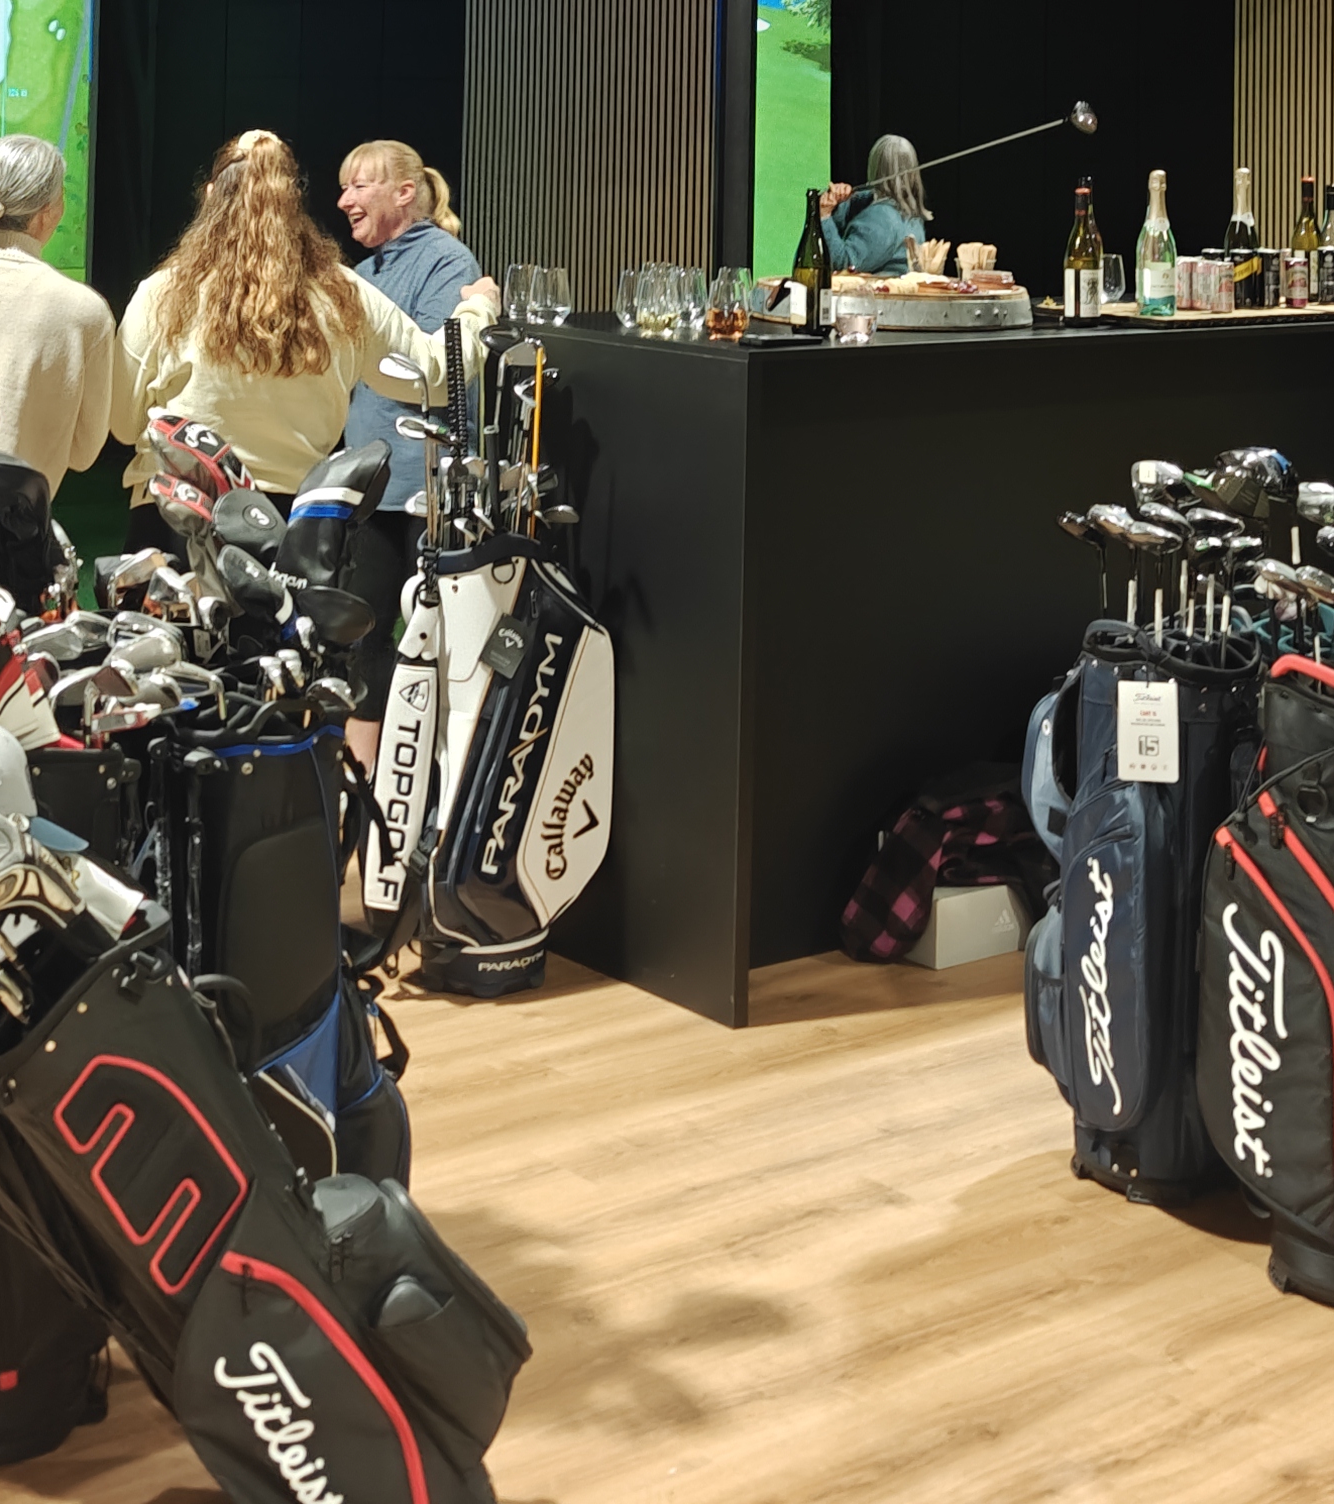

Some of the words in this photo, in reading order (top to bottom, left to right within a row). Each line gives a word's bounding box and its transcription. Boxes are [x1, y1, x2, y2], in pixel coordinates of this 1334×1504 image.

[537, 752, 595, 882] Callaway
[1079, 857, 1122, 1116] Titleist
[1222, 902, 1289, 1177] Titleist
